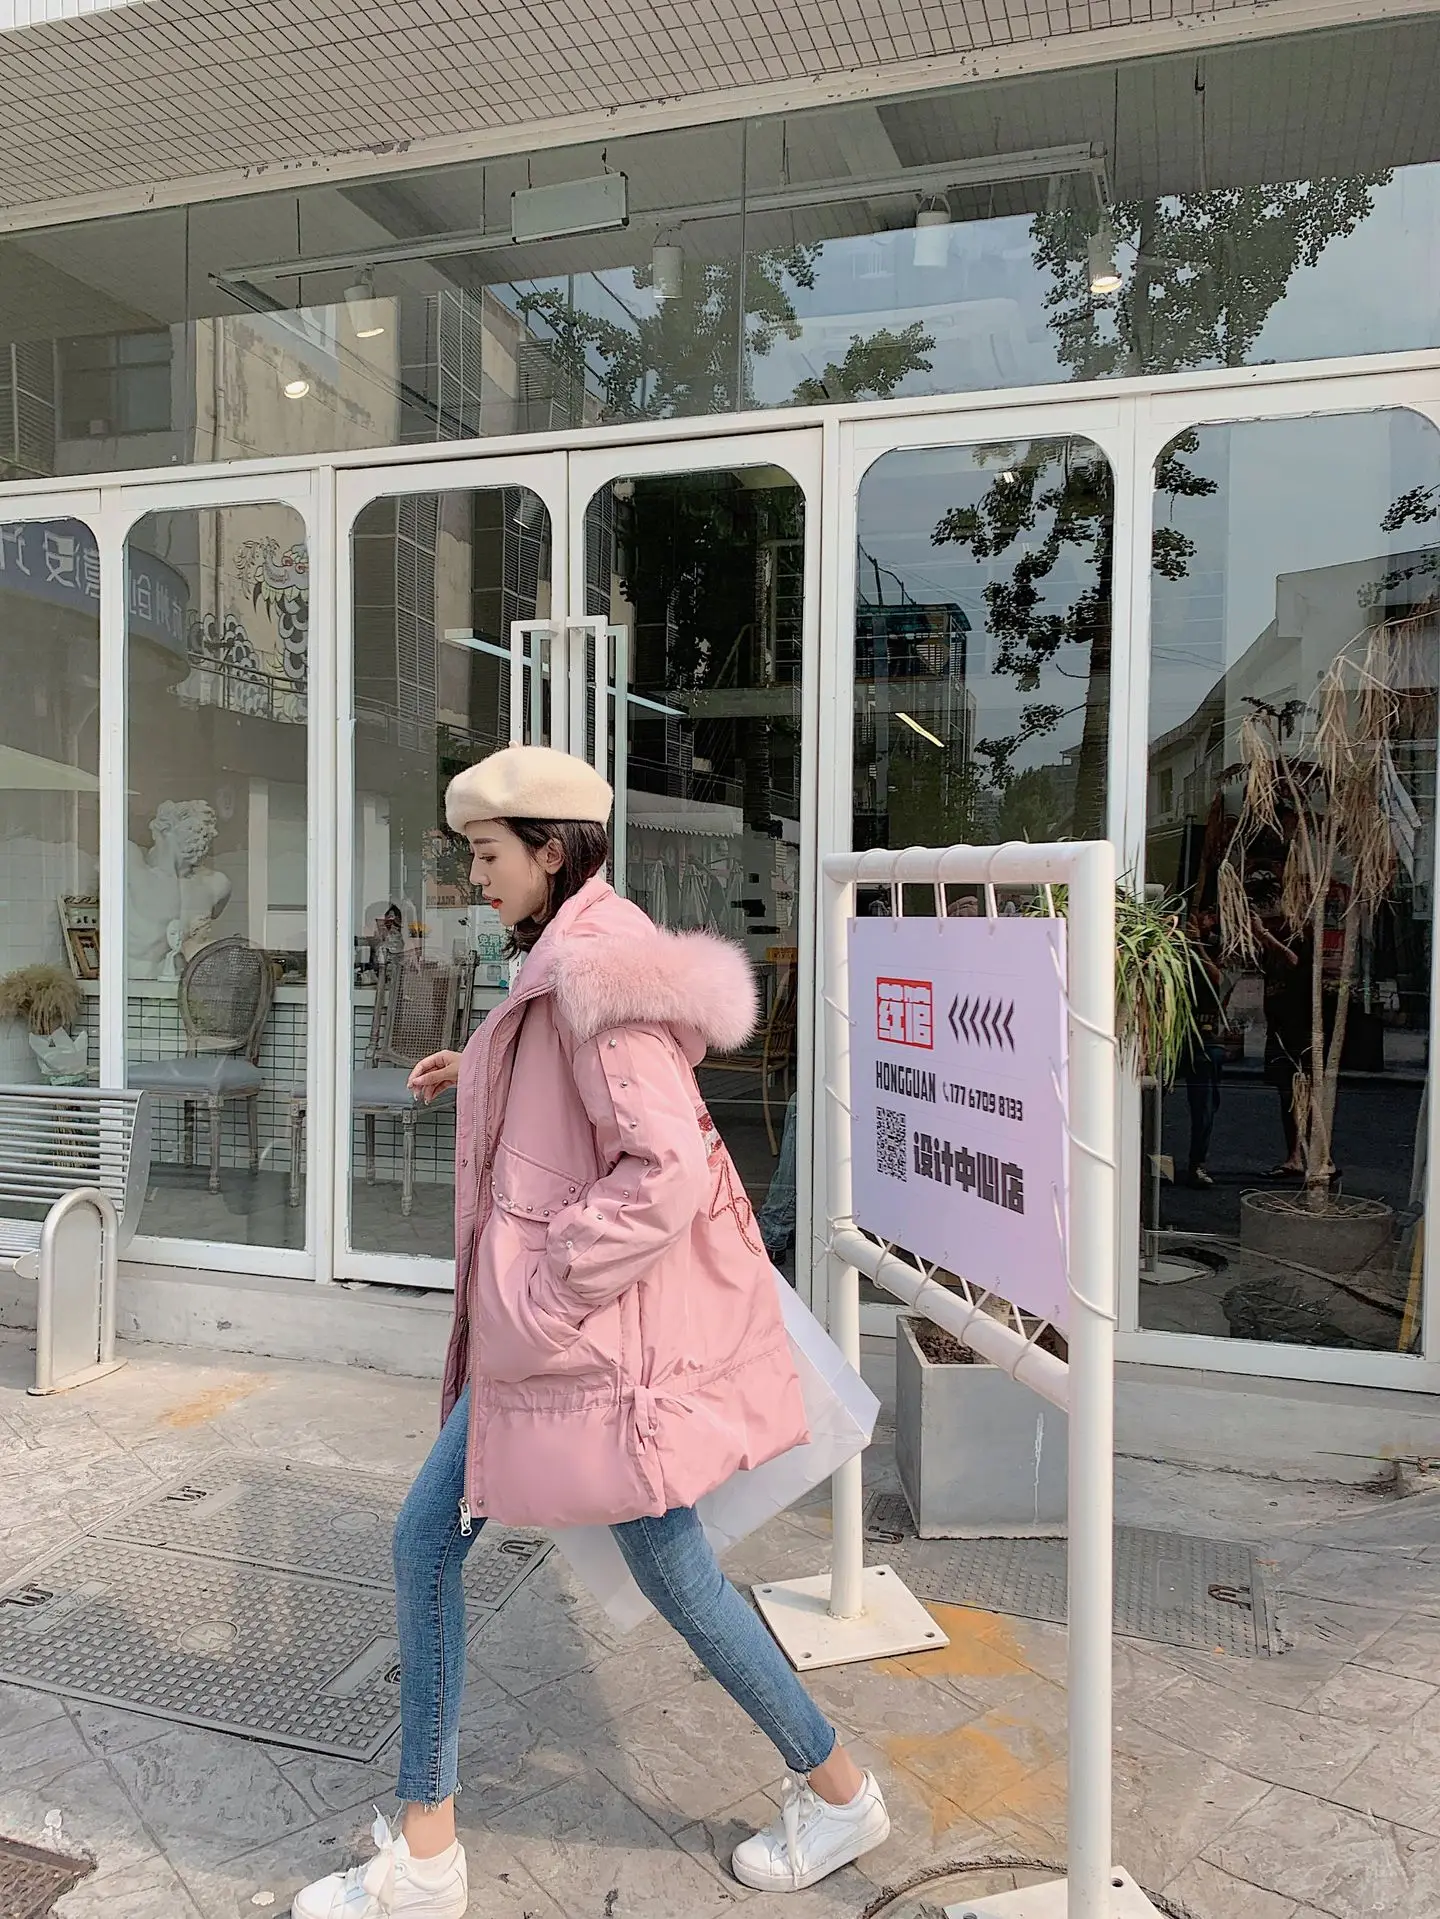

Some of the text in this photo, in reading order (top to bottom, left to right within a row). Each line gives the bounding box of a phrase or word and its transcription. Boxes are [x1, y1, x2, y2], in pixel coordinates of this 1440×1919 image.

[875, 1060, 937, 1104] HONGGUAN
[949, 1083, 1024, 1122] 177 6709 8133
[913, 1131, 1024, 1215] 设计中心店
